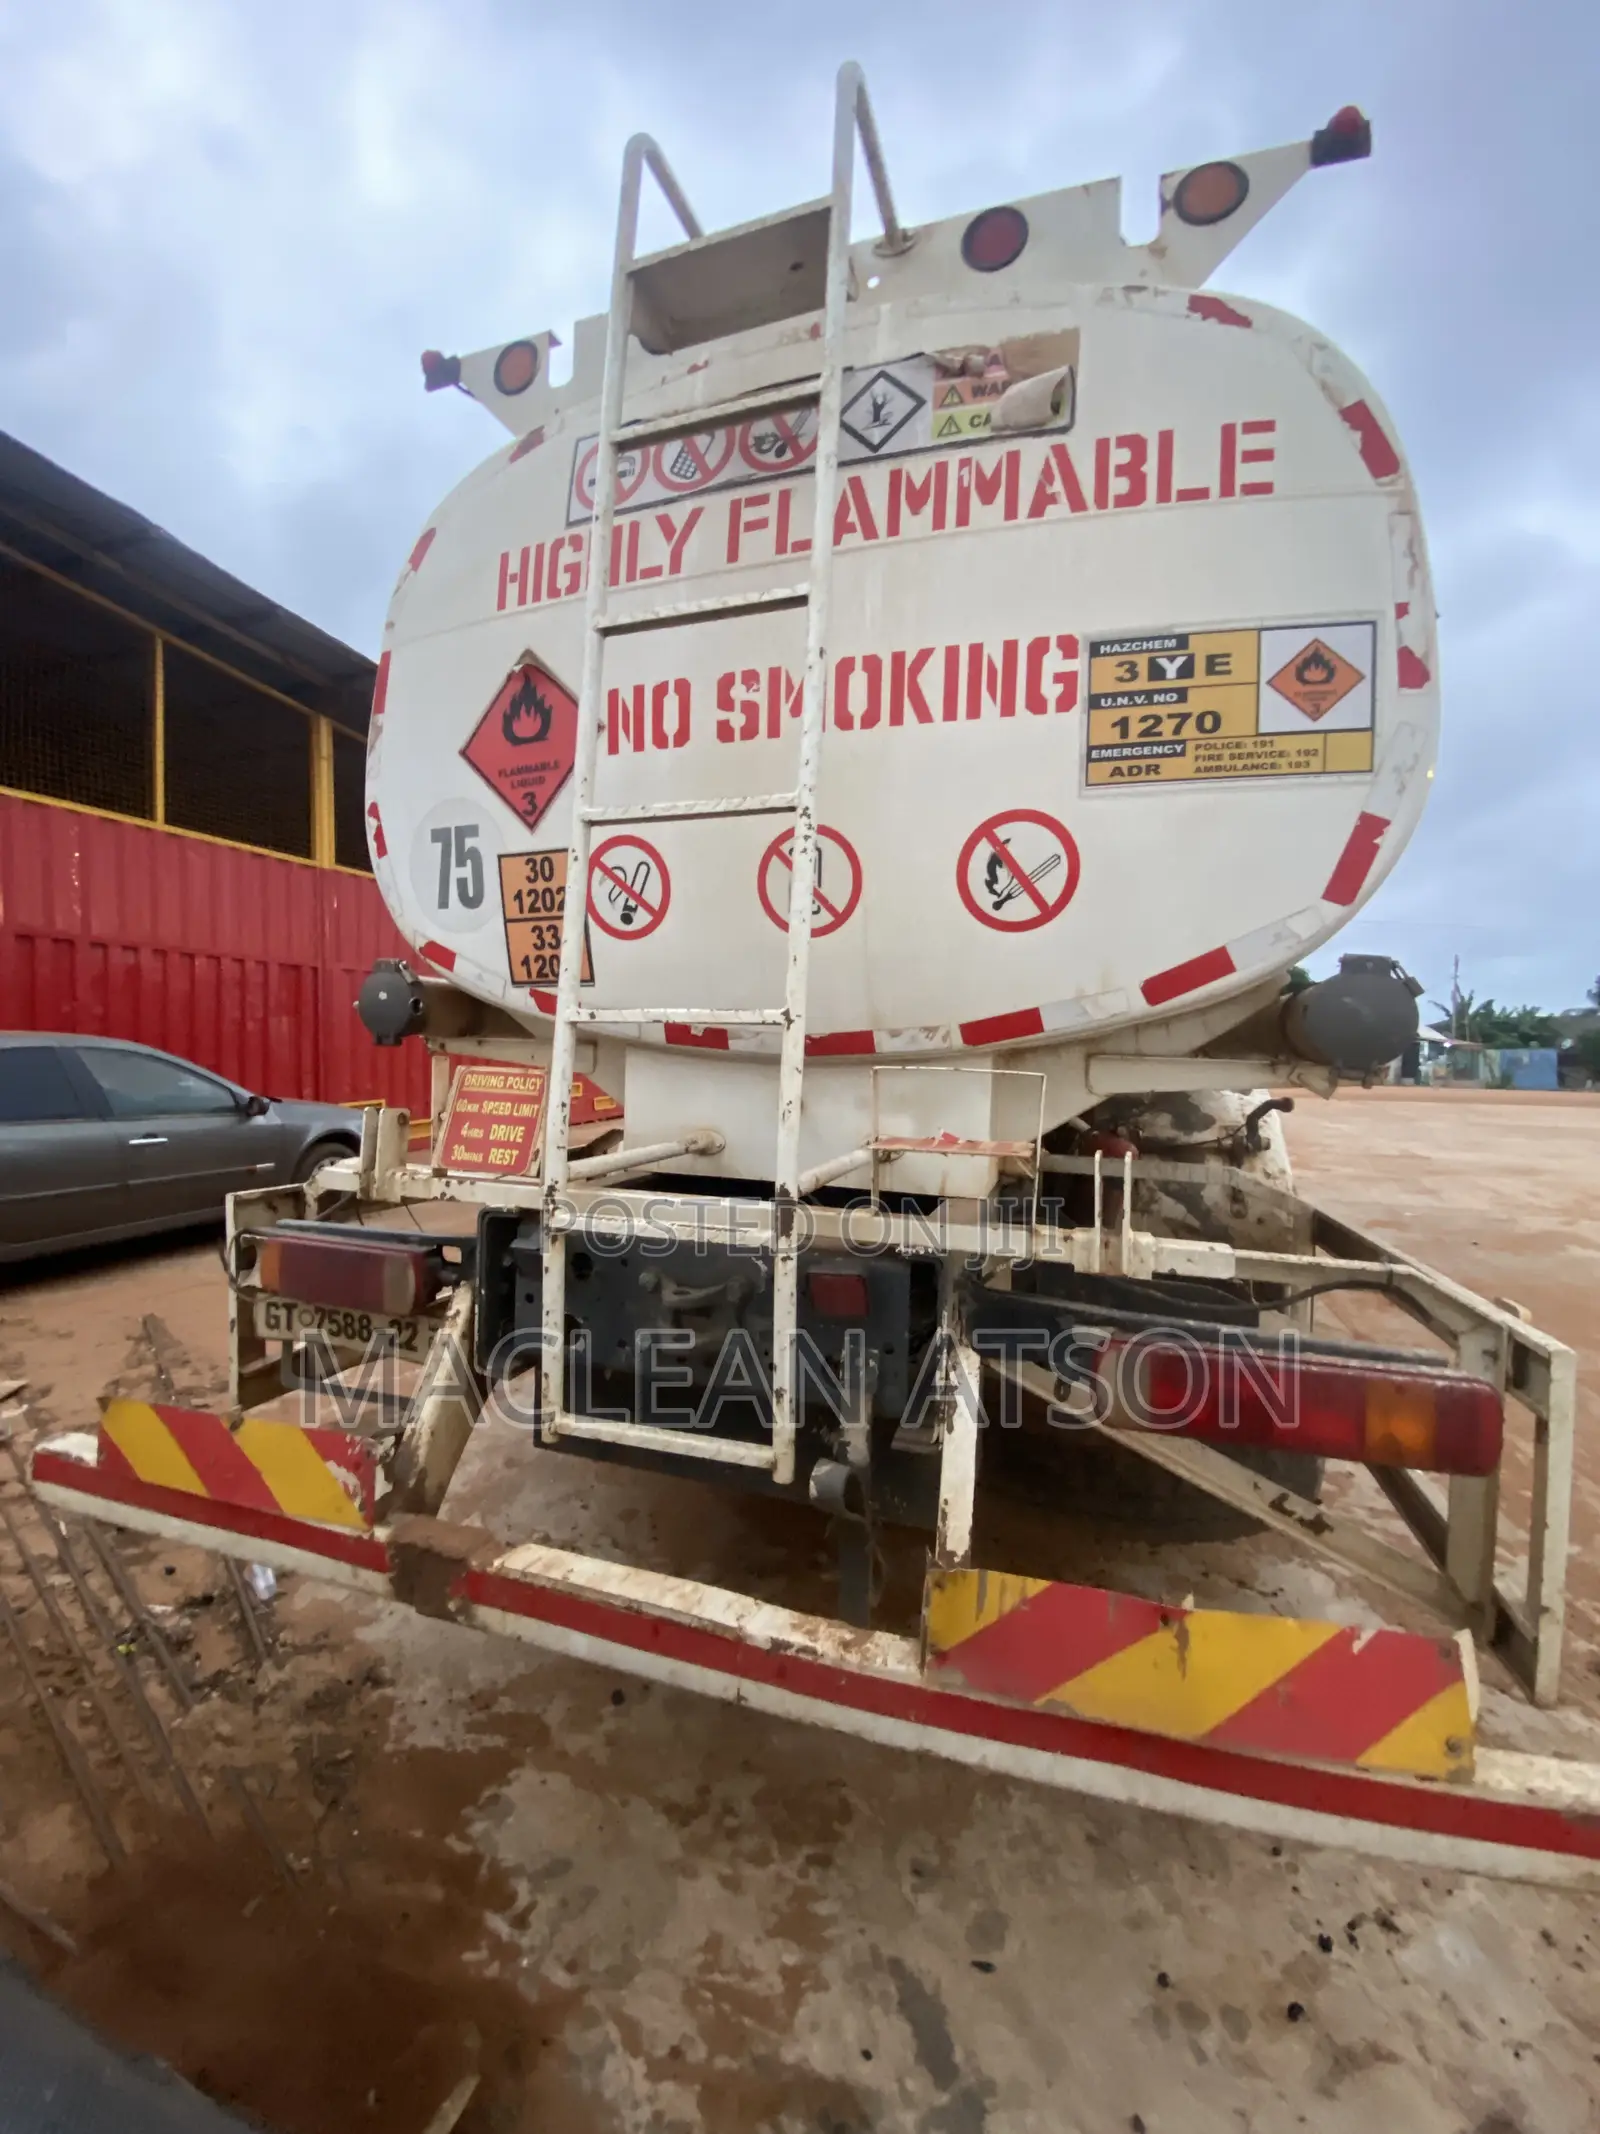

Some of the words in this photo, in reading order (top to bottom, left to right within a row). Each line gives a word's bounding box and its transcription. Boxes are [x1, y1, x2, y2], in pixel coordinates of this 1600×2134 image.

[727, 419, 1276, 564] FLAMMABLE
[1100, 638, 1177, 655] HAZCHEM
[607, 677, 691, 756] NO
[716, 634, 1080, 744] SMOKING
[1100, 694, 1148, 707] U.N.V.
[1153, 692, 1178, 704] NO
[1111, 711, 1222, 740] 1270
[1091, 744, 1185, 759] EMERGENCY
[1194, 740, 1247, 752] POLICE:
[1194, 752, 1224, 763] FIRE
[1229, 750, 1291, 761] SERVICE:
[498, 759, 560, 779] FLAMMABLE
[1109, 764, 1162, 778] ADR
[1194, 761, 1282, 774] AMBULANCE:
[522, 791, 538, 816] 3
[430, 824, 486, 911] 75
[525, 856, 554, 884] 30
[531, 924, 560, 951] 33
[521, 954, 560, 980] 120
[464, 1074, 505, 1088] DRIVING
[506, 1075, 543, 1091] POLICY
[481, 1100, 512, 1116] SPEED
[513, 1102, 540, 1118] LIMIT
[489, 1124, 525, 1143] DRIVE
[488, 1148, 519, 1166] REST
[265, 1301, 298, 1332] GT
